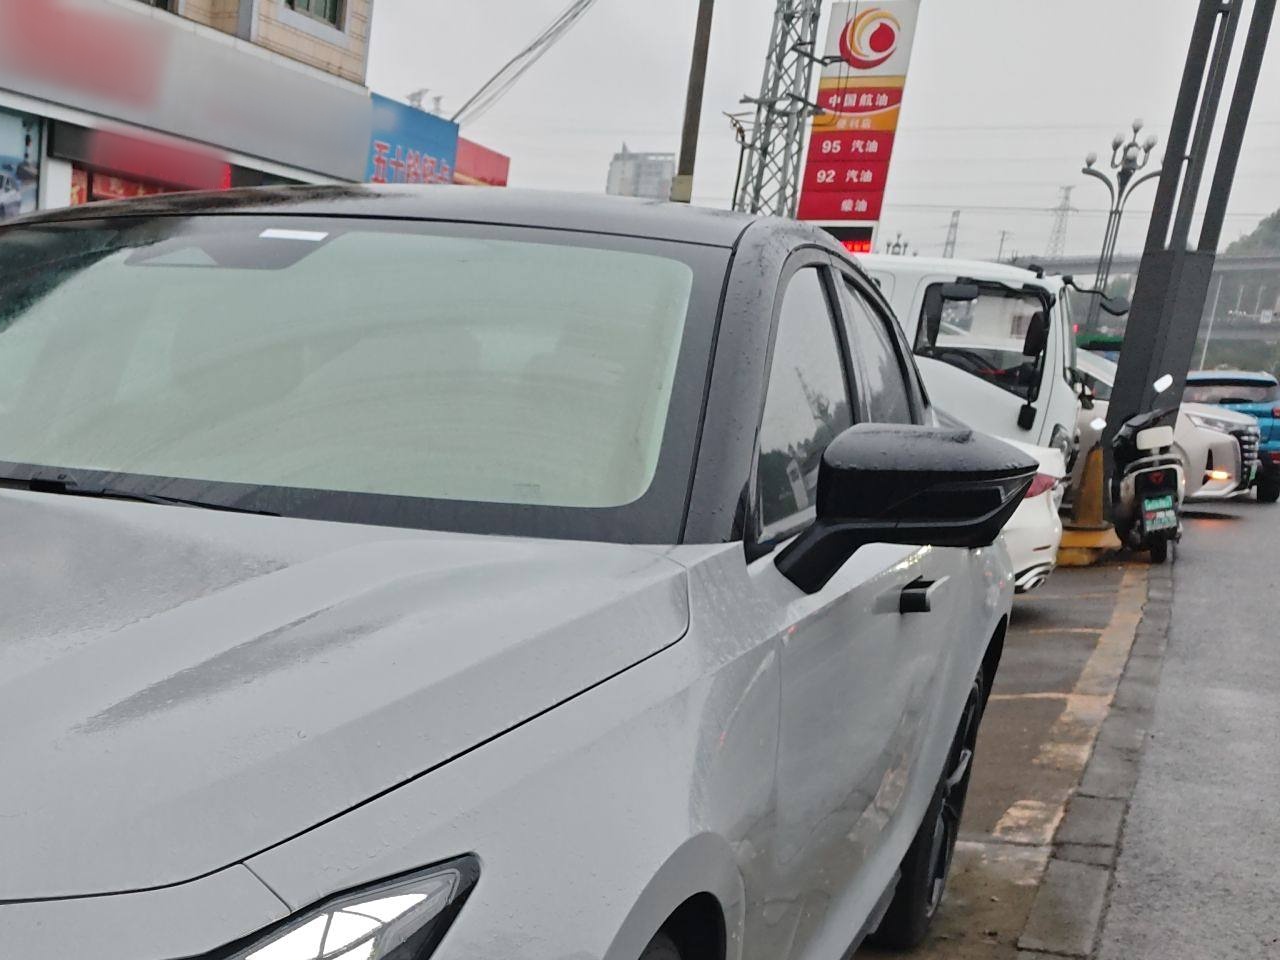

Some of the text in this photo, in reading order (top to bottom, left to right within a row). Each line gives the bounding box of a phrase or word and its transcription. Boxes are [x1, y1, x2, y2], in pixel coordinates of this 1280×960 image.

[821, 139, 878, 154] 95 汽油
[816, 168, 872, 183] 92 汽油
